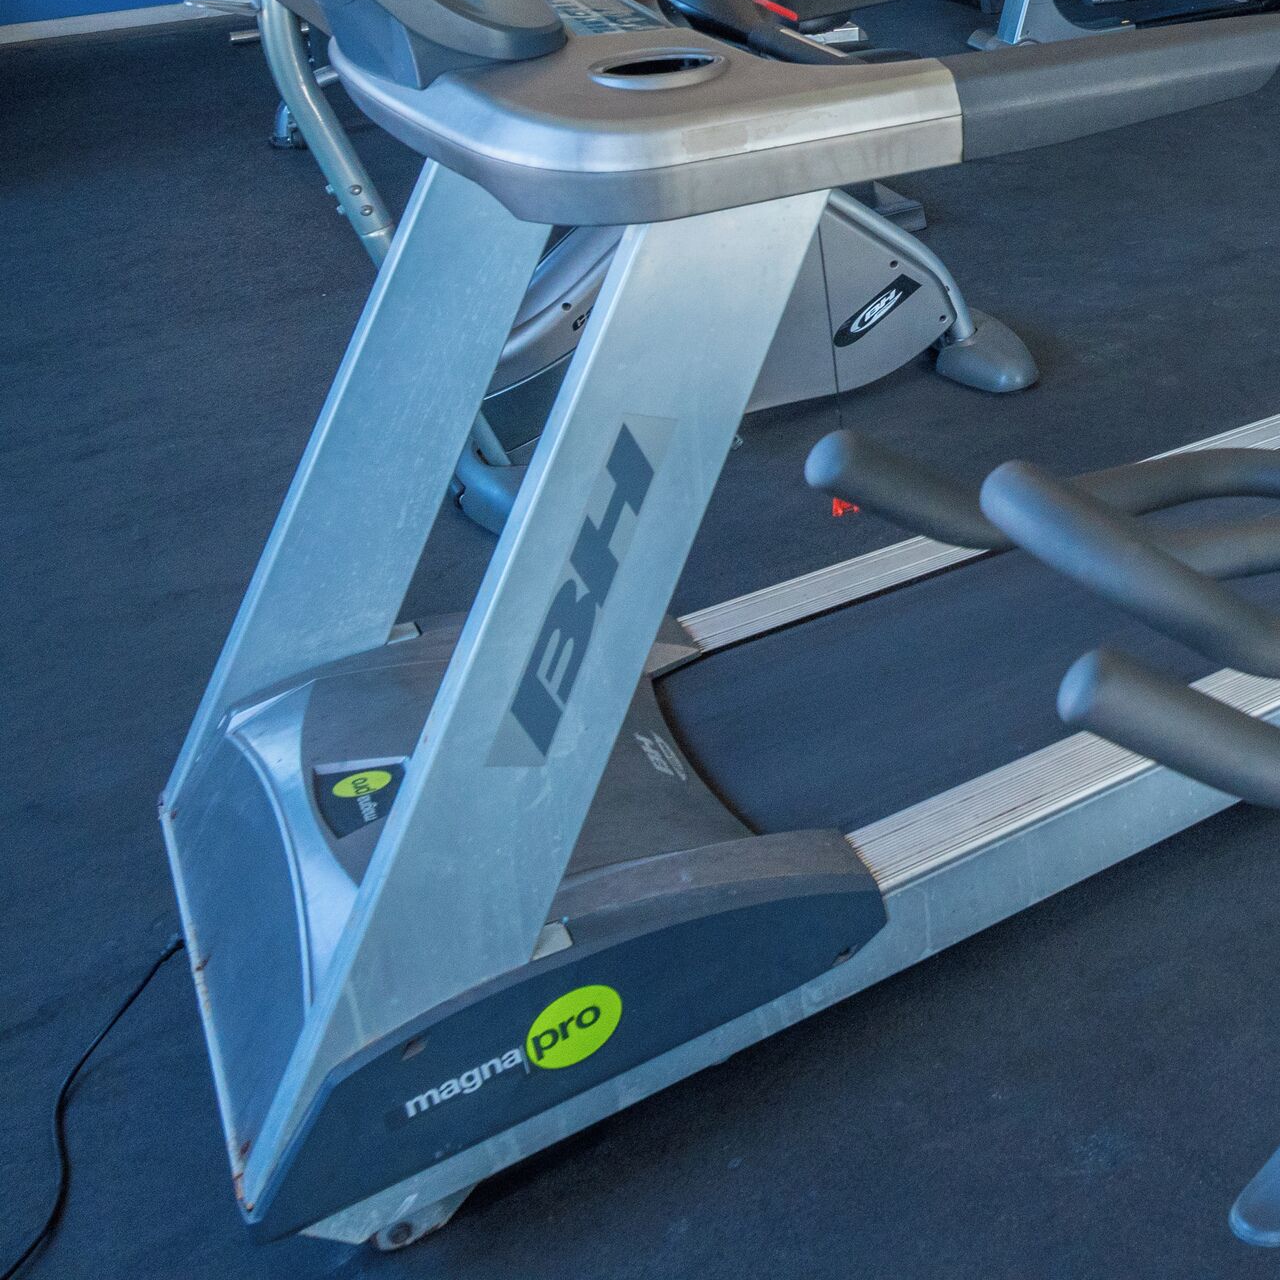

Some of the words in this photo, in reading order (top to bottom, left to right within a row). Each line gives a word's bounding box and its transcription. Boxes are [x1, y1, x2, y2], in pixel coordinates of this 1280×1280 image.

[510, 422, 656, 758] BH
[404, 1047, 523, 1118] magna
[531, 1005, 601, 1062] pro
